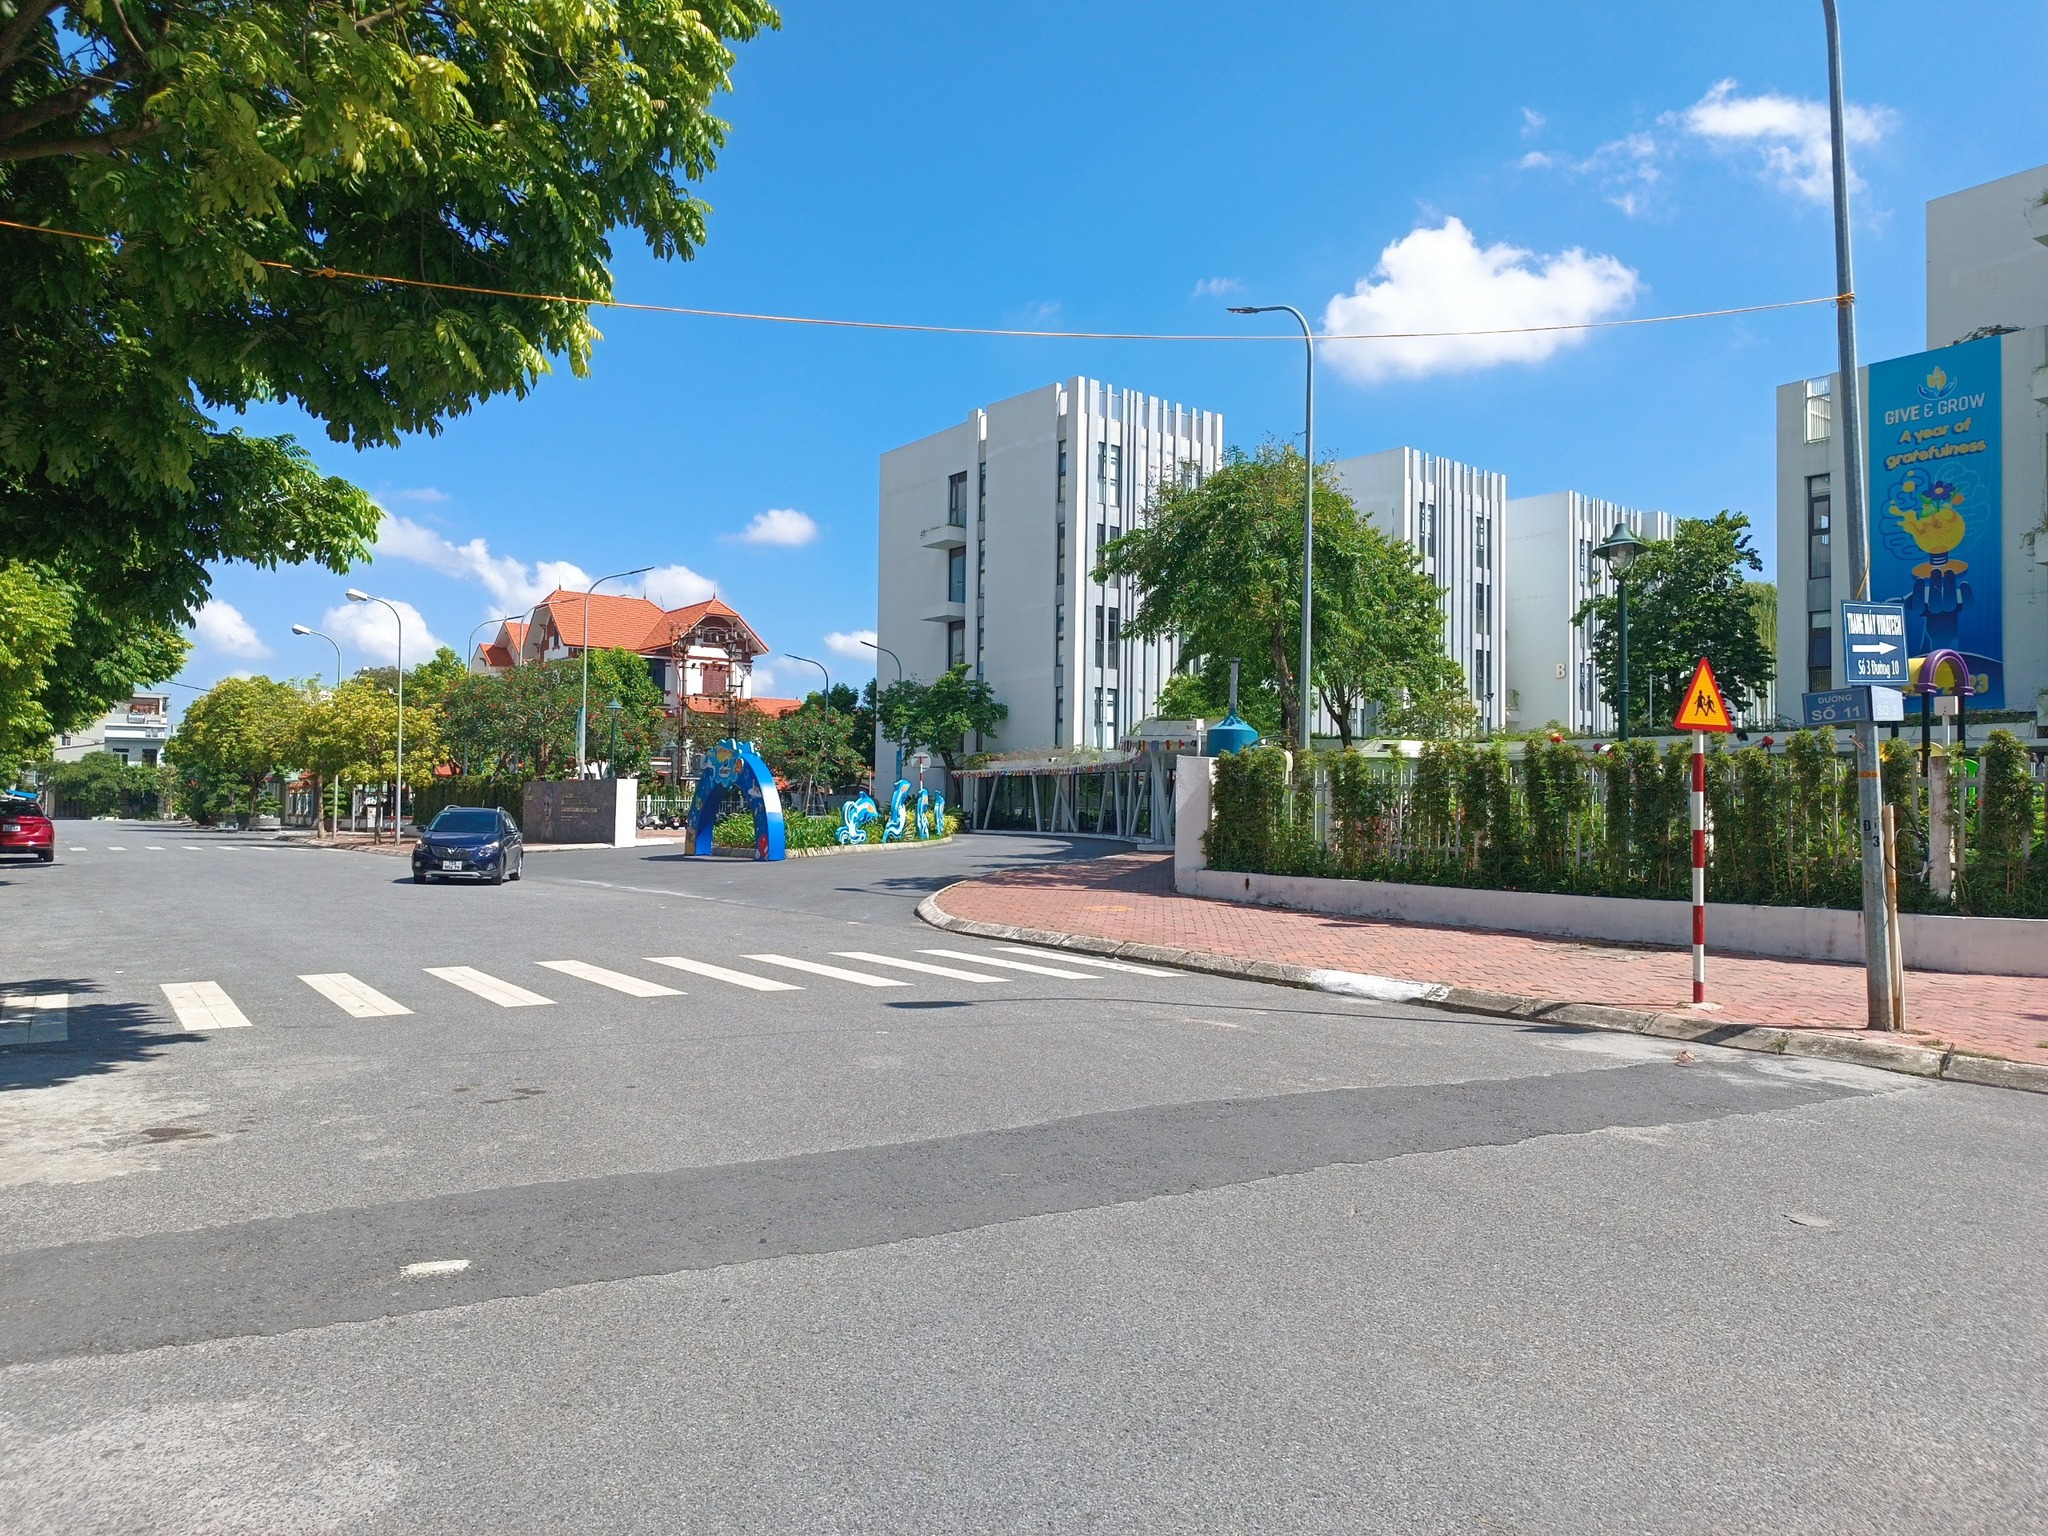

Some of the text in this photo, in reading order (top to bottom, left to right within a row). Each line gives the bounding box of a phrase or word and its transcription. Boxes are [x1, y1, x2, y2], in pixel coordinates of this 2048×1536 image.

[1884, 392, 1985, 425] GIVE & GROW
[1899, 417, 1972, 443] A year of
[1884, 439, 1987, 470] gratefulness
[1556, 663, 1567, 679] B
[1857, 657, 1866, 675] Số
[1866, 660, 1871, 675] 3
[1891, 660, 1900, 675] 10
[1811, 704, 1860, 721] SỐ 11
[1872, 835, 1880, 848] 3
